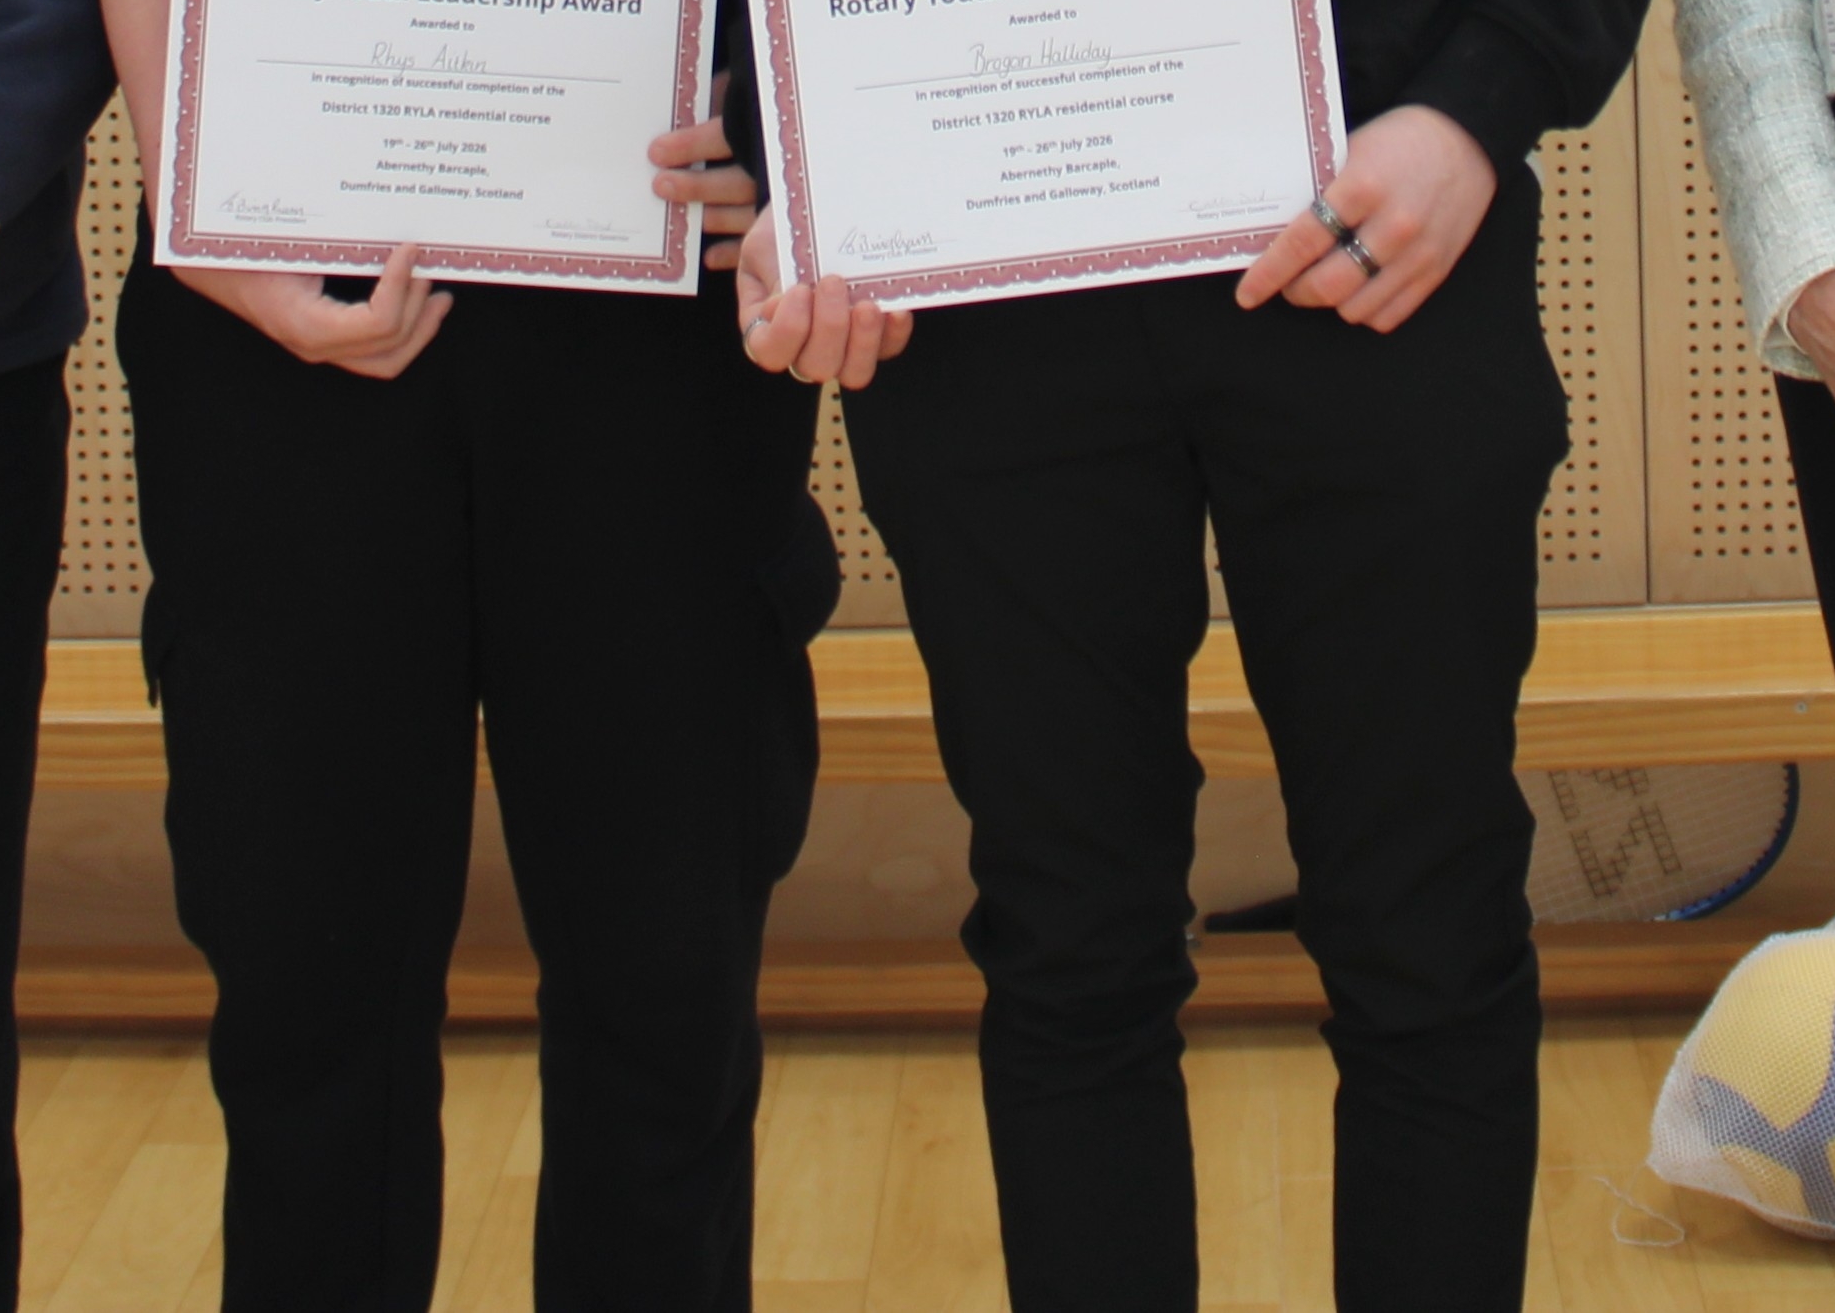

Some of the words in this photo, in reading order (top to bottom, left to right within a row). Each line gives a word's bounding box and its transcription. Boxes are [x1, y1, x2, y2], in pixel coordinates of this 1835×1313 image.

[410, 18, 461, 32] Awarded
[463, 21, 476, 32] to
[1009, 9, 1061, 26] Awarded
[1064, 8, 1077, 19] to
[371, 41, 415, 78] Rhys
[1041, 36, 1113, 68] Halliday
[325, 74, 389, 87] recognition
[392, 77, 404, 87] of
[406, 78, 463, 90] successful
[466, 81, 529, 96] completion
[532, 84, 544, 95] of
[546, 86, 565, 96] the
[930, 82, 997, 101] recognition
[1000, 80, 1013, 91] of
[1015, 73, 1076, 90] successful
[1079, 63, 1145, 82] completion
[1149, 61, 1162, 73] of
[1164, 59, 1184, 71] the
[322, 101, 369, 115] District
[372, 104, 401, 116] 1320
[404, 105, 436, 118] RYLA
[438, 107, 506, 122] residential
[509, 114, 551, 125] course
[931, 115, 981, 131] District
[985, 111, 1015, 125] 1320
[1018, 105, 1052, 120] RYLA
[1055, 95, 1127, 116] residential
[1130, 92, 1175, 108] course
[436, 141, 458, 154] July
[1060, 138, 1083, 153] July
[1085, 135, 1113, 149] 2026
[376, 160, 435, 175] Abernethy
[438, 164, 490, 177] Barcaple,
[1000, 164, 1062, 183] Abernethy
[1066, 157, 1121, 175] Barcaple,
[340, 181, 392, 193] Dumfries
[395, 182, 416, 194] and
[419, 185, 472, 198] Galloway,
[475, 187, 523, 200] Scotland
[966, 193, 1021, 210] Dumfries
[1024, 191, 1046, 204] and
[1049, 184, 1106, 201] Galloway,
[1108, 176, 1161, 193] Scotland
